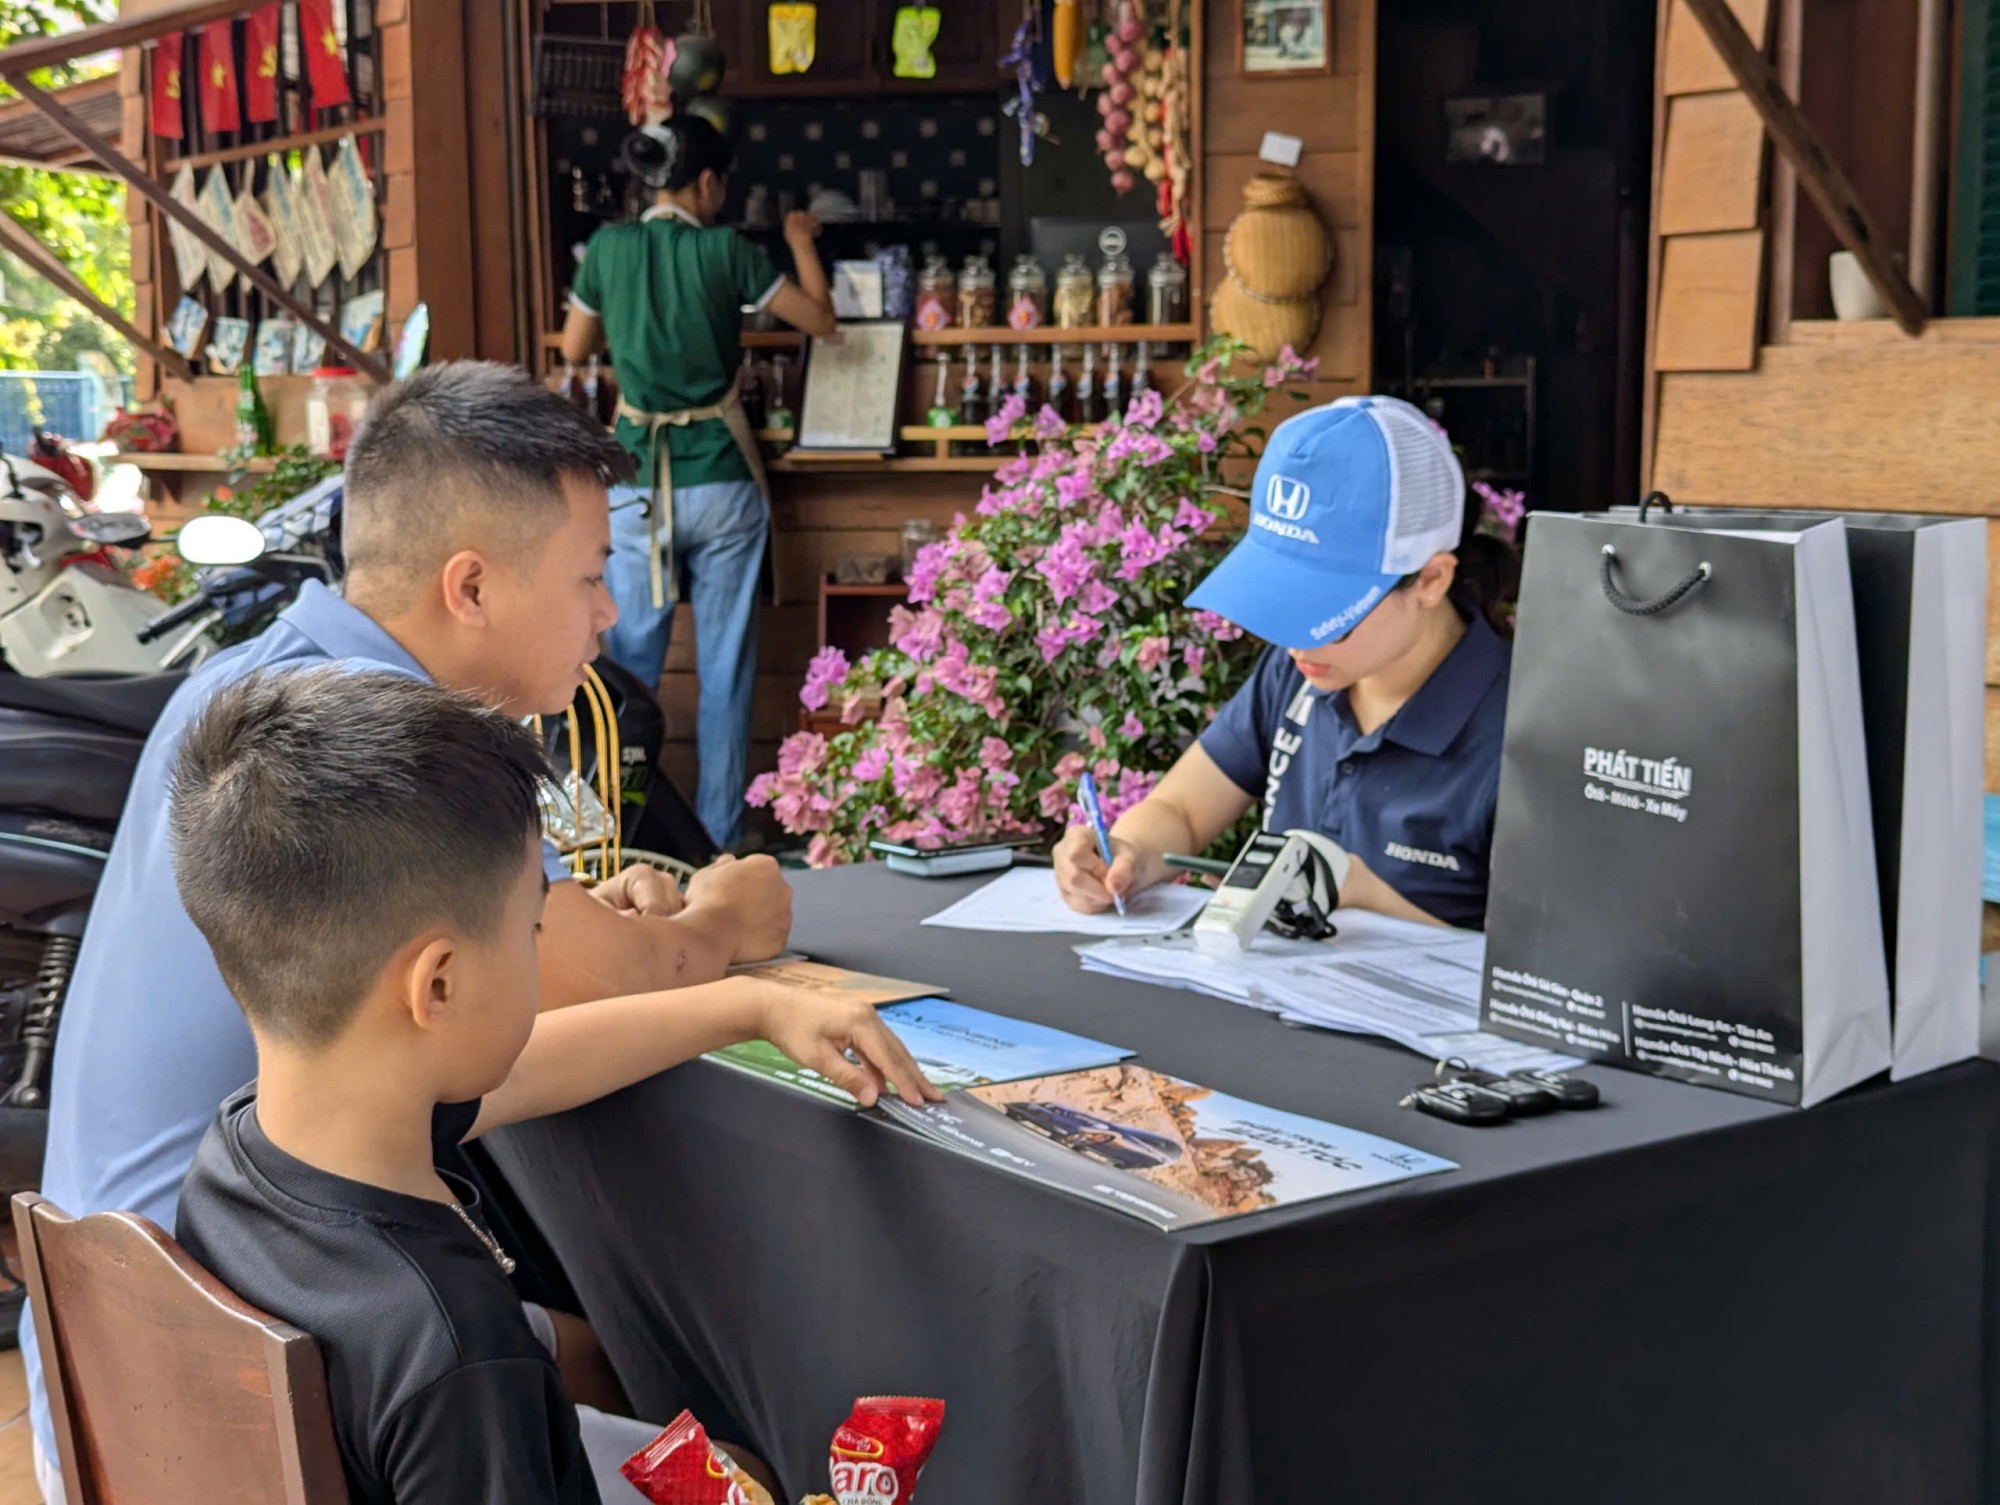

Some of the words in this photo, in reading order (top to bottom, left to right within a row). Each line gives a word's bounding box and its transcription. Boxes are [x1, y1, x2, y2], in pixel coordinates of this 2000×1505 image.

[1253, 512, 1319, 544] HONDA
[1584, 747, 1639, 780] PHÁT
[1641, 757, 1692, 791] TIẾN
[1385, 841, 1461, 872] HONDA
[830, 1460, 898, 1497] aro
